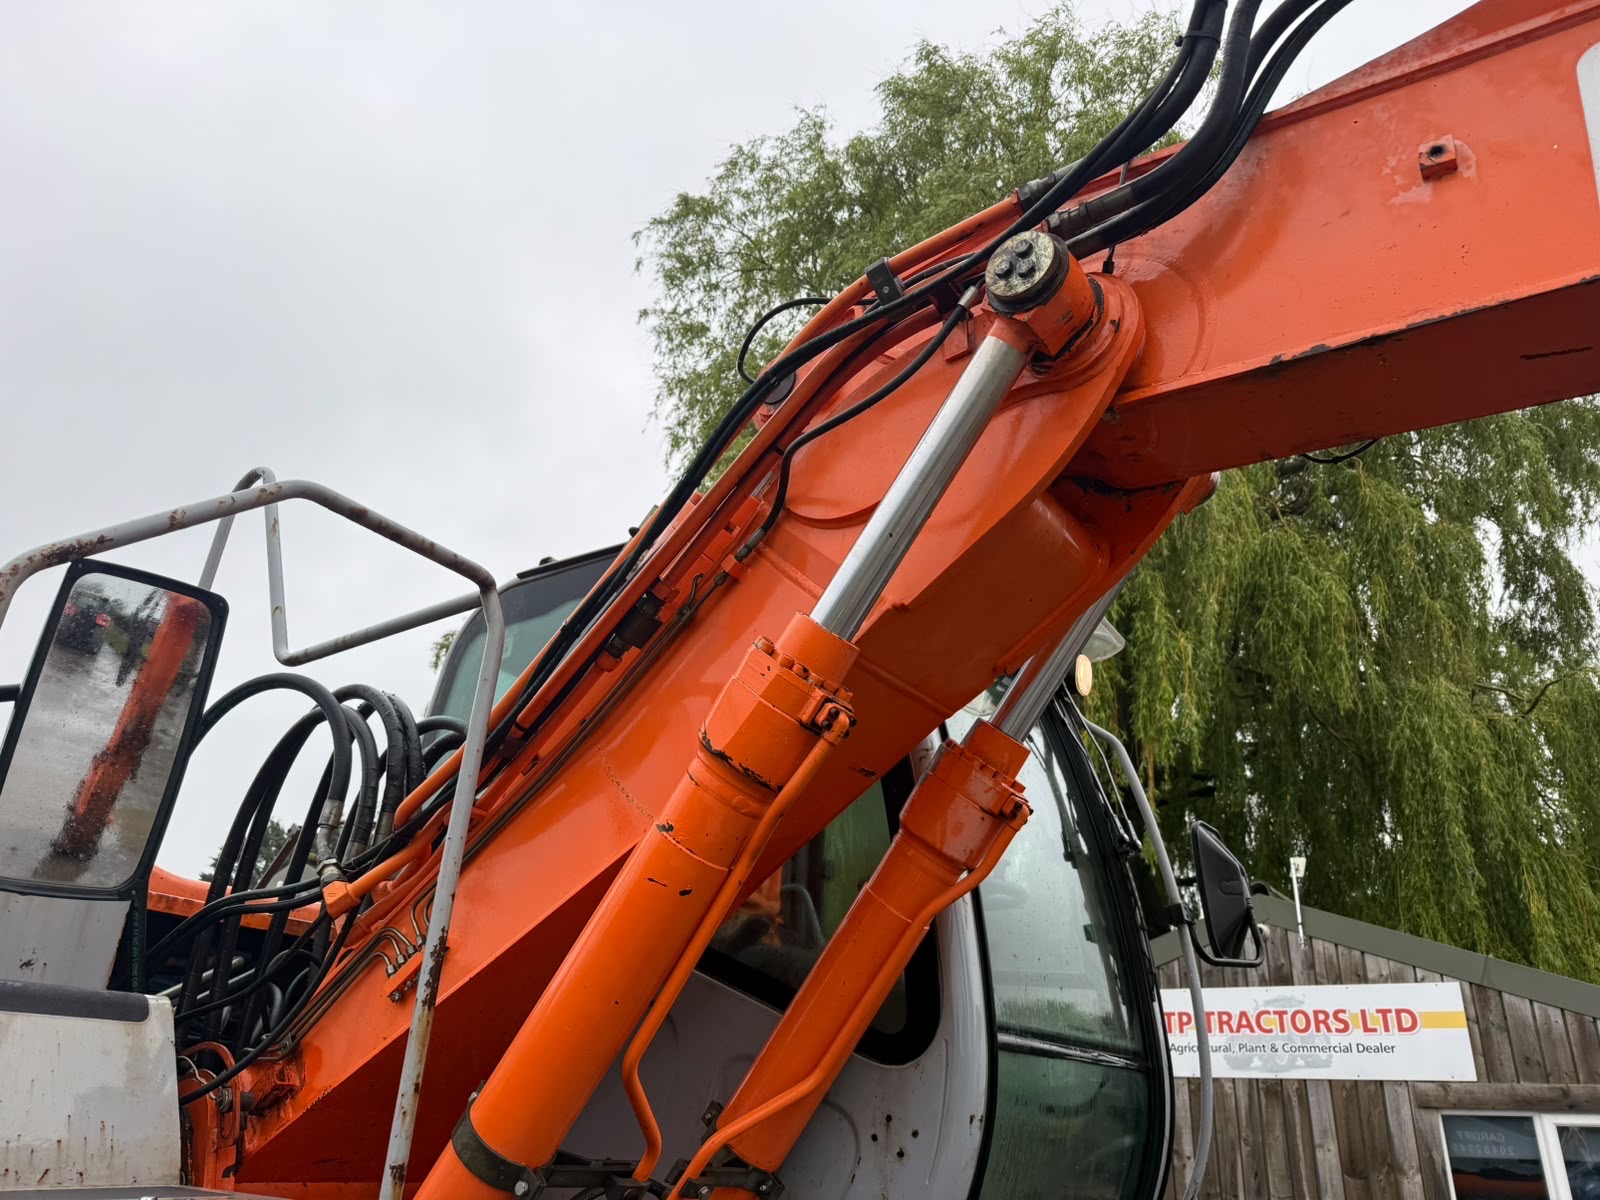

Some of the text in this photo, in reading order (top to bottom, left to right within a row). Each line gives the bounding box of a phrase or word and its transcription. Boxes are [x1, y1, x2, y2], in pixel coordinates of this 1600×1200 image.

[1204, 1008, 1350, 1034] TRACTORS
[1360, 1008, 1418, 1033] LTD
[1169, 1042, 1396, 1056] Agricural, Plant & Commercial Dealer
